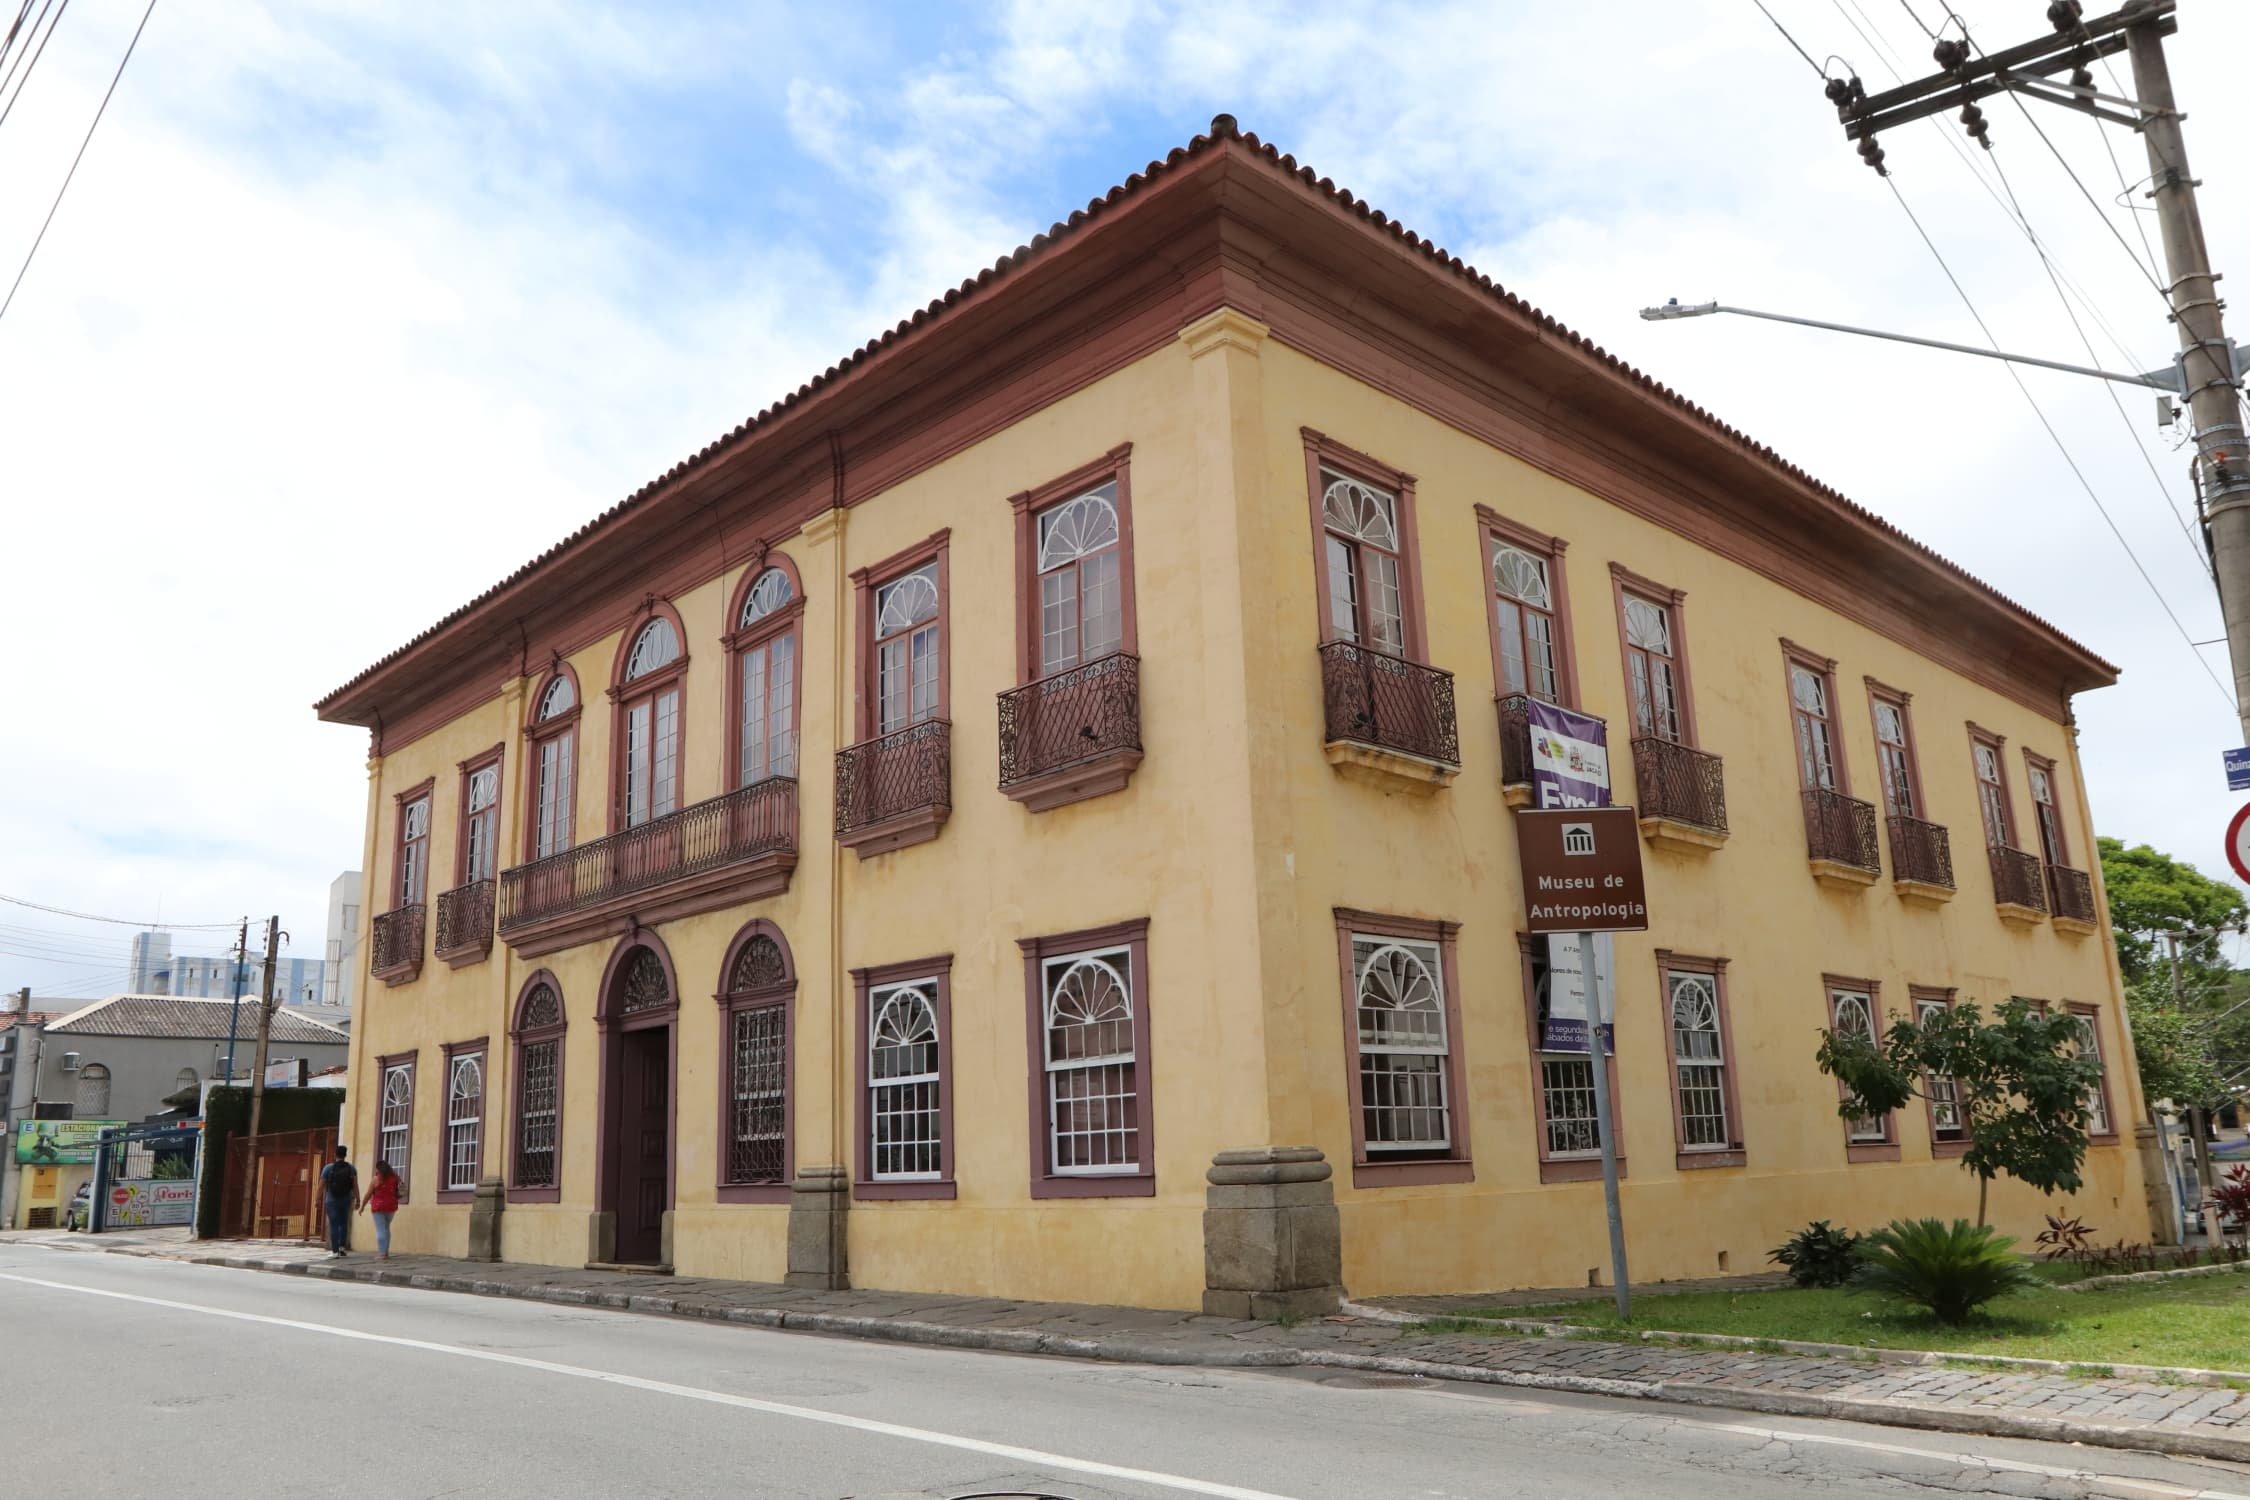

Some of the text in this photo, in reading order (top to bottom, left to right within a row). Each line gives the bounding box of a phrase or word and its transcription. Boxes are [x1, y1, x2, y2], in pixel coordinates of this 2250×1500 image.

[1538, 874, 1624, 890] Museu de
[1530, 901, 1644, 920] Antropologia
